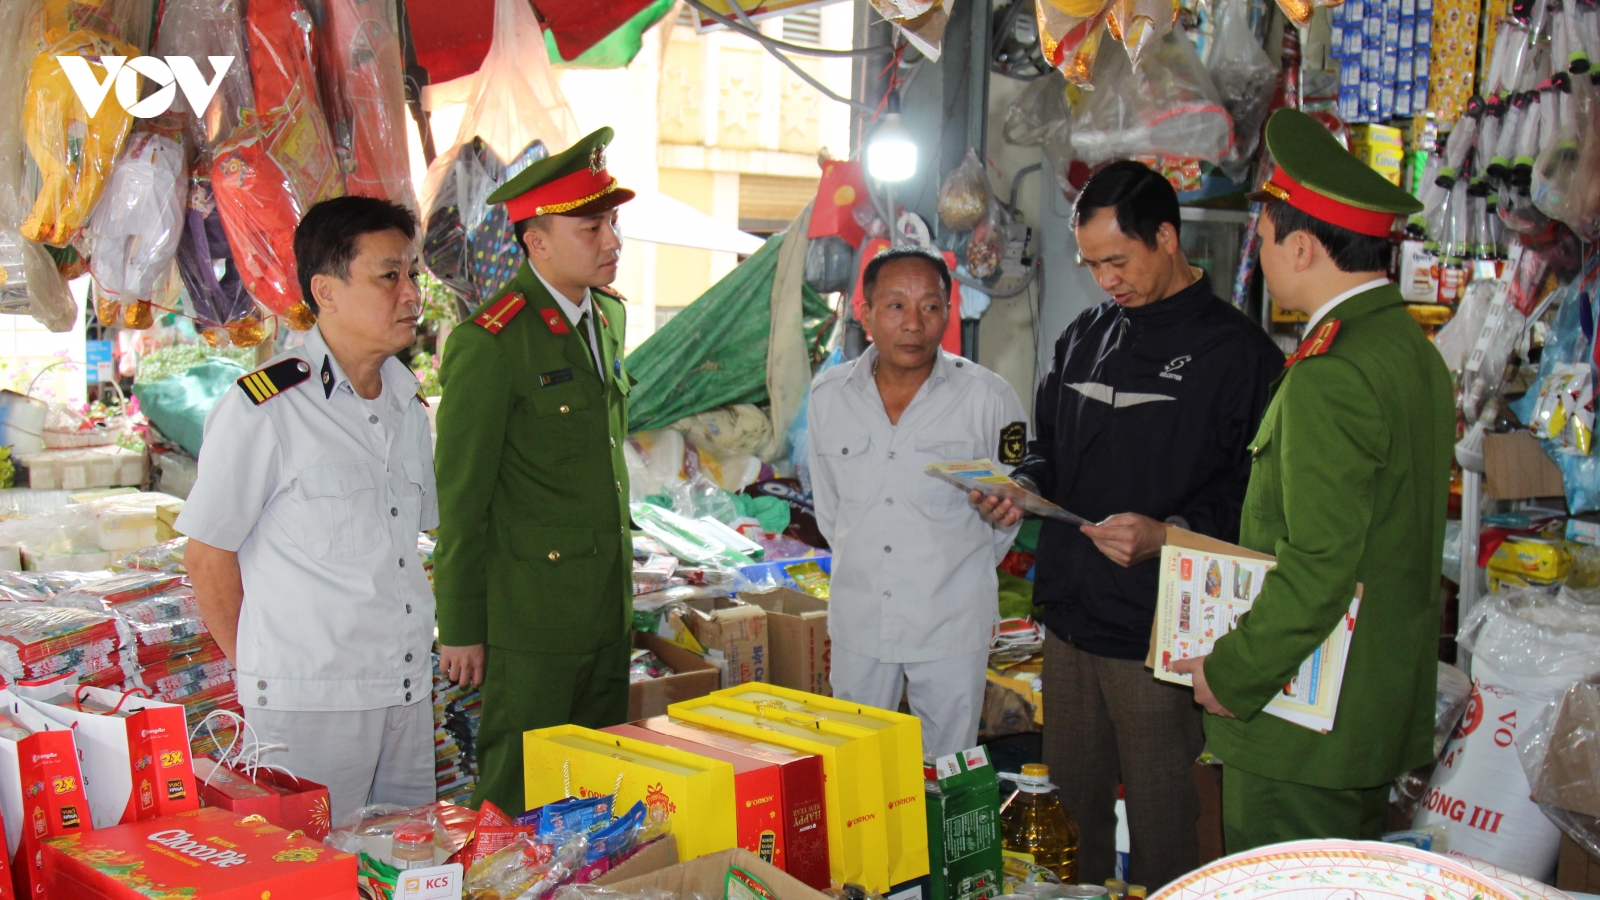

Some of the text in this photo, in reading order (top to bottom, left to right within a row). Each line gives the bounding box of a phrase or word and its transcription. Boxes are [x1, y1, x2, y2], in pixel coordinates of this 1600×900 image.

[754, 668, 764, 683] Ca
[160, 750, 184, 768] 2X
[53, 776, 77, 795] 2X
[751, 796, 774, 806] ORION
[895, 796, 917, 808] ORION
[792, 803, 821, 817] NEW YEAR
[1422, 786, 1505, 834] CÔNG III
[793, 810, 821, 827] HAPPY
[853, 813, 877, 827] ORION
[426, 876, 449, 890] KCS
